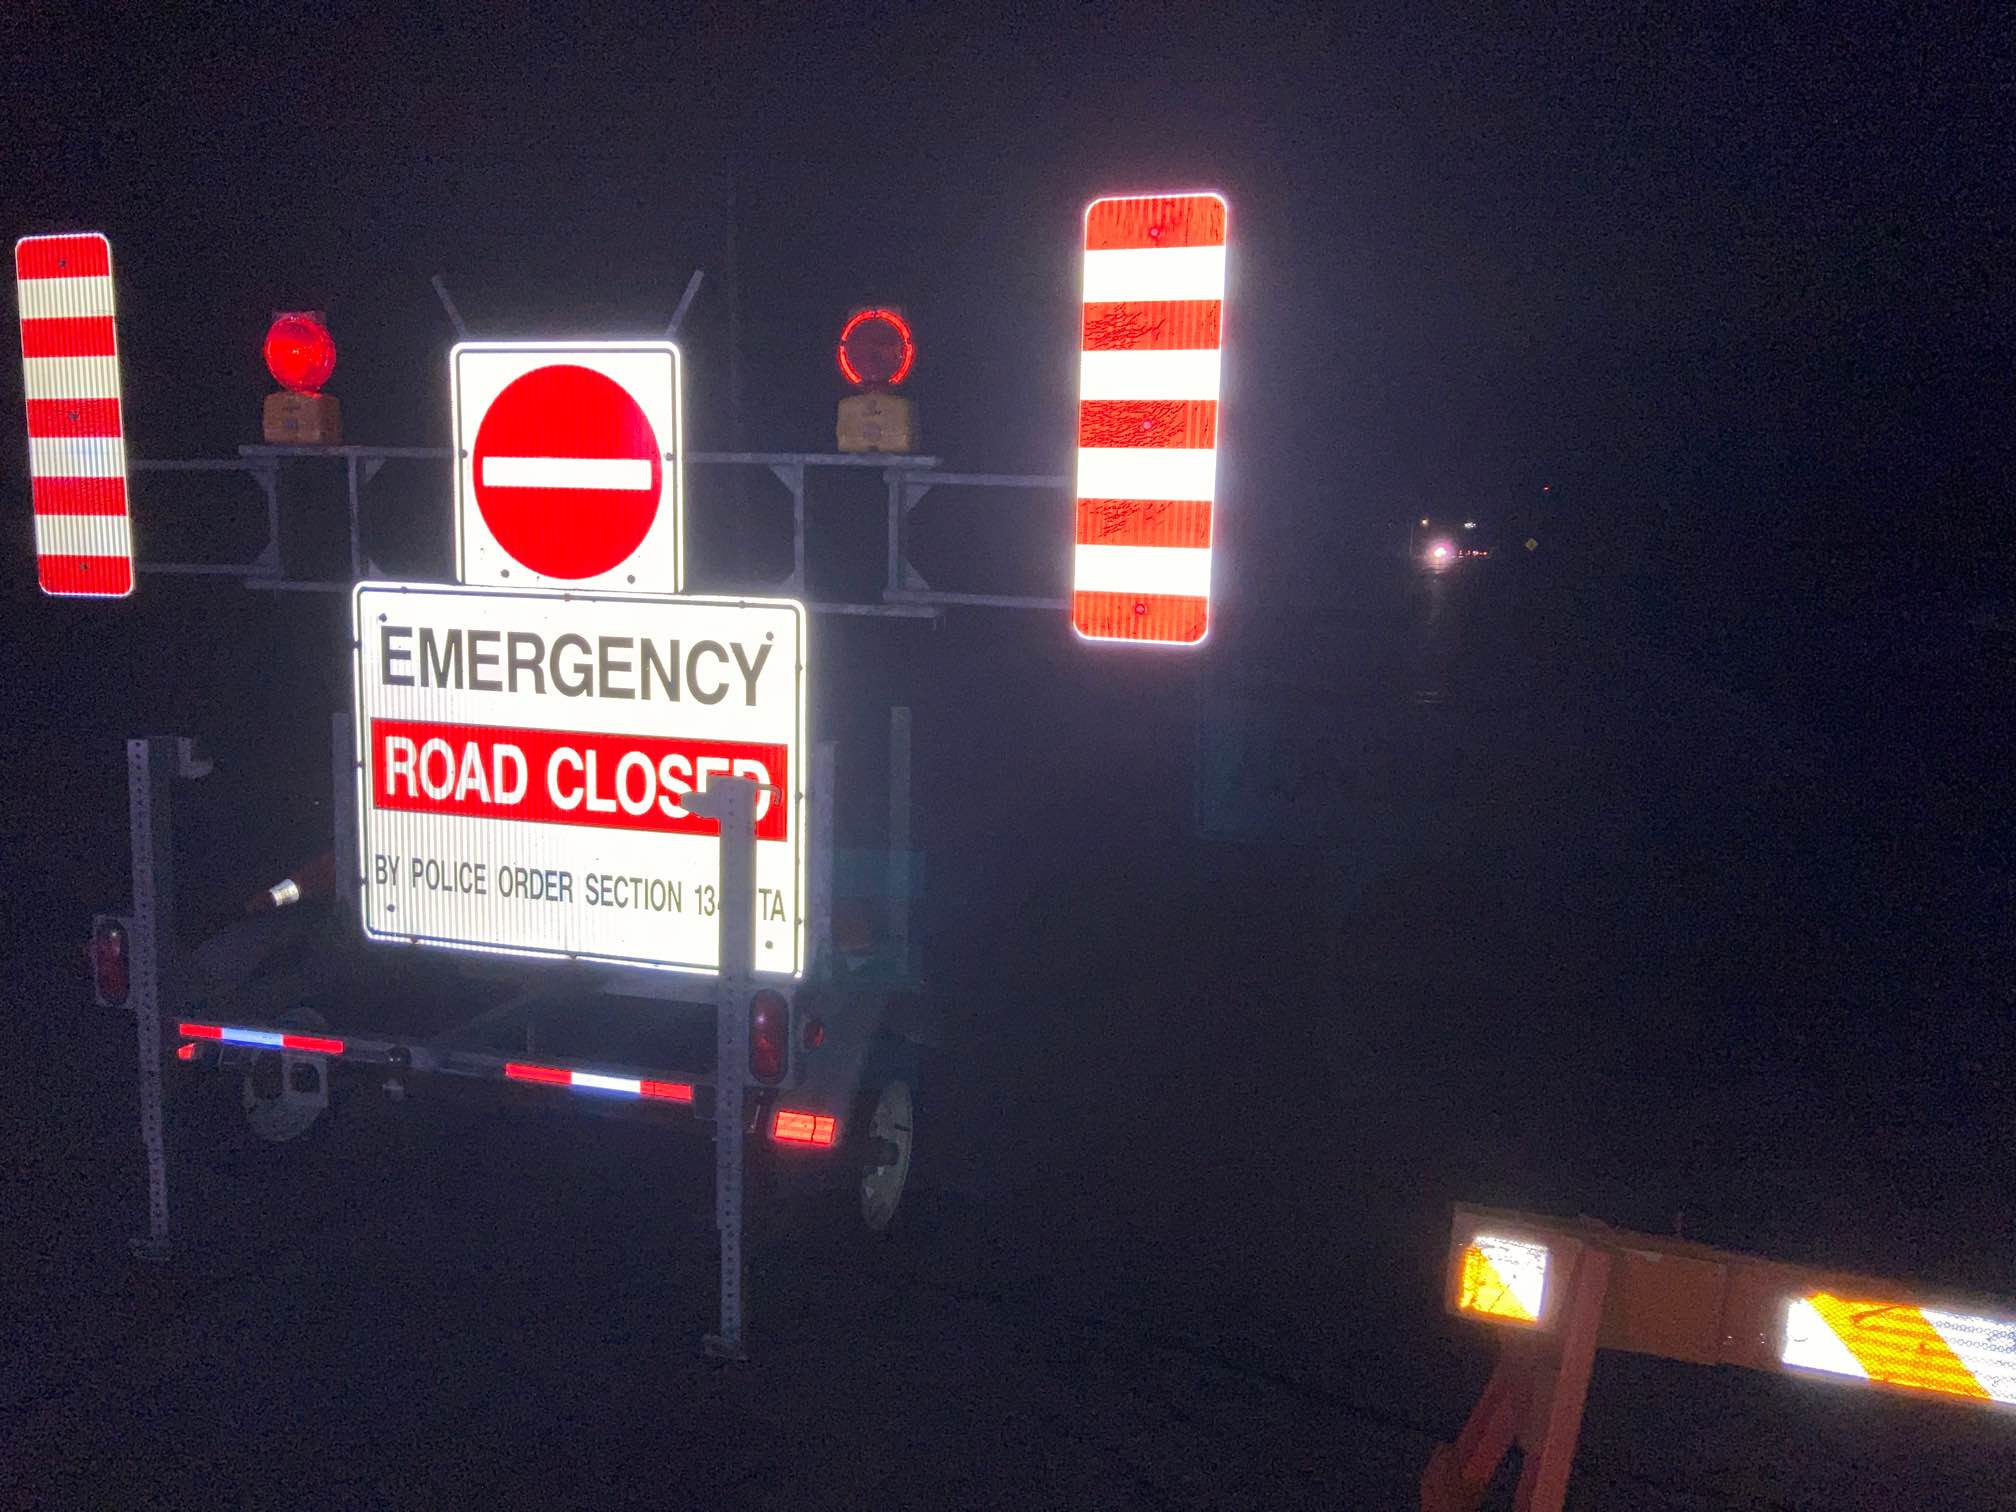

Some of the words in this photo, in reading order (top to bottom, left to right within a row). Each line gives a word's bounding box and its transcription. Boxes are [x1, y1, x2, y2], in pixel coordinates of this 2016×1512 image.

[381, 626, 773, 706] EMERGENCY
[385, 736, 528, 805] ROAD
[375, 854, 400, 886] BY
[412, 857, 486, 894] POLICE
[498, 866, 574, 903] ORDER
[585, 873, 682, 912] SECTION
[694, 885, 720, 916] 13
